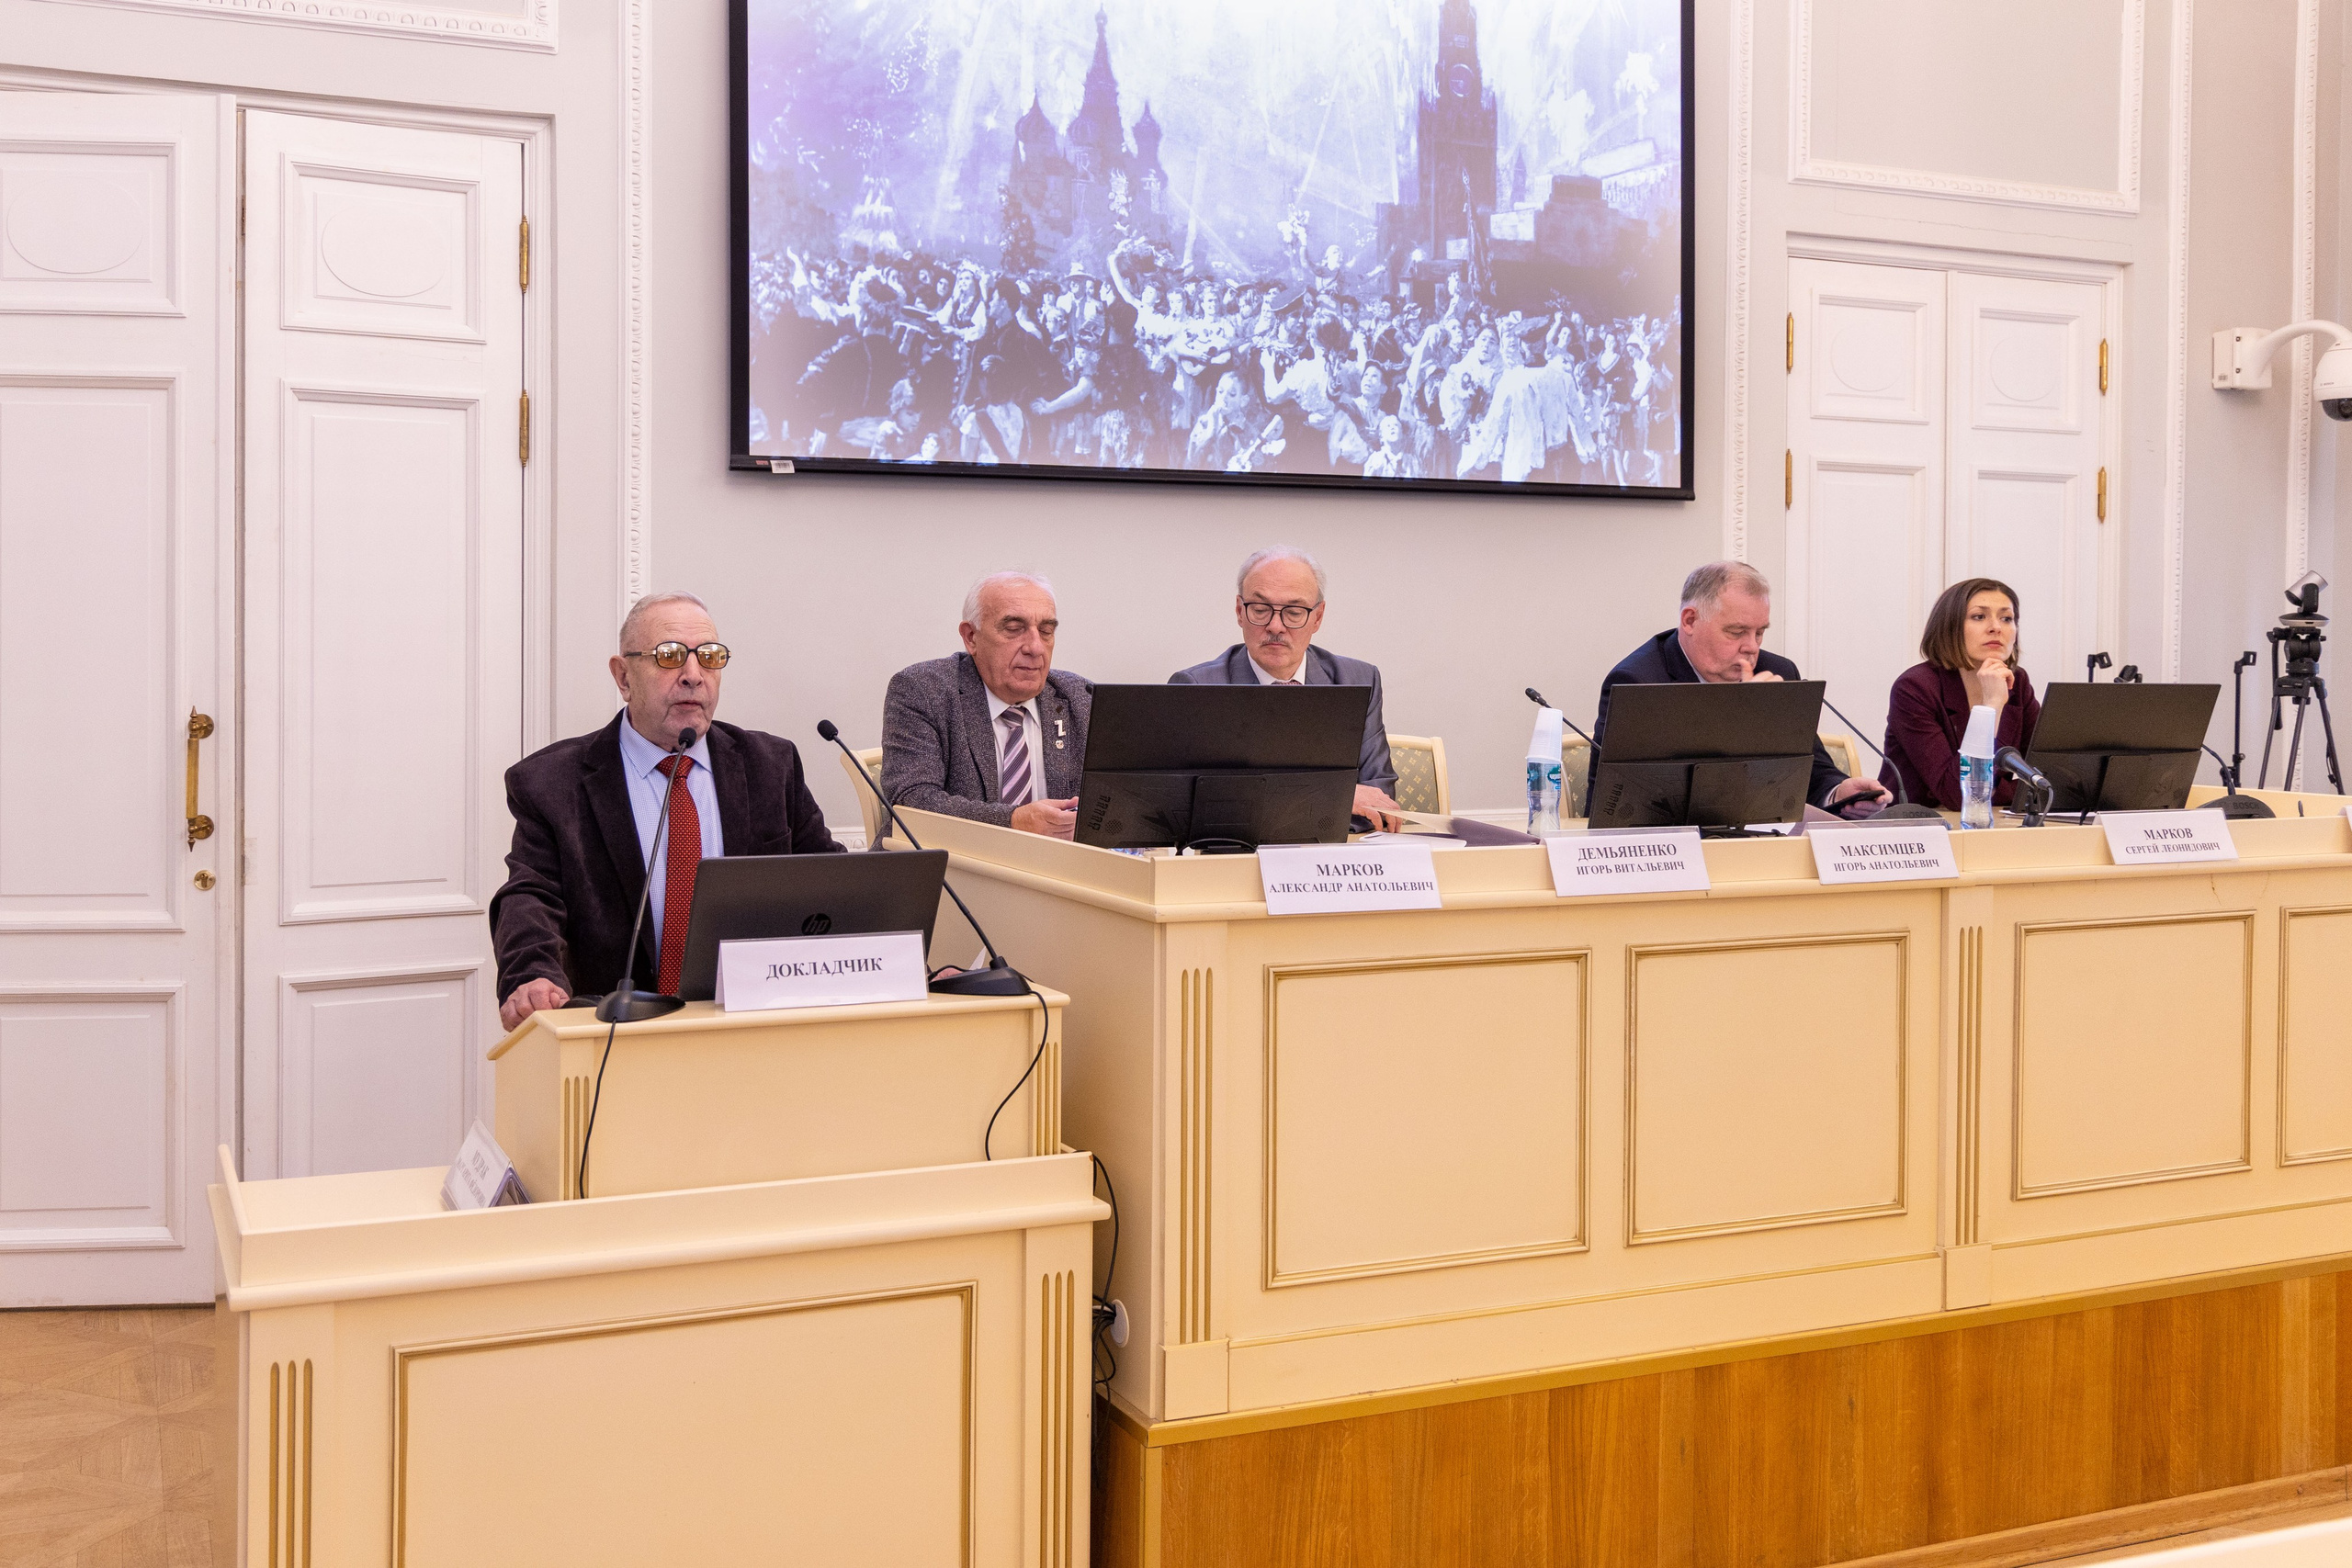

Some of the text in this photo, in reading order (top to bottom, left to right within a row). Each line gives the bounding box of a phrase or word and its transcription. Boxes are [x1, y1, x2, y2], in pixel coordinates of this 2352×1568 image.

[2233, 801, 2260, 809] BOSCH
[2143, 828, 2194, 840] МАРКОВ
[1577, 843, 1678, 862] ДЕМЬЯНЕНКО
[1840, 842, 1926, 857] МАКСИМЦЕВ
[2125, 842, 2222, 855] СЕРГЕЙ ЛЕОНИДОВИЧ
[1316, 863, 1385, 876] МАРКОВ
[1576, 861, 1685, 875] ИГОРЬ ВИТАЛЬЕВИЧ
[1833, 859, 1939, 872] ИГОРЬ АНАТОЛЬЕВИЧ
[1269, 881, 1435, 894] АЛЕКСАНДР АНАТОЛЬЕВИЧ
[765, 957, 883, 981] ДОКЛАДЧИК
